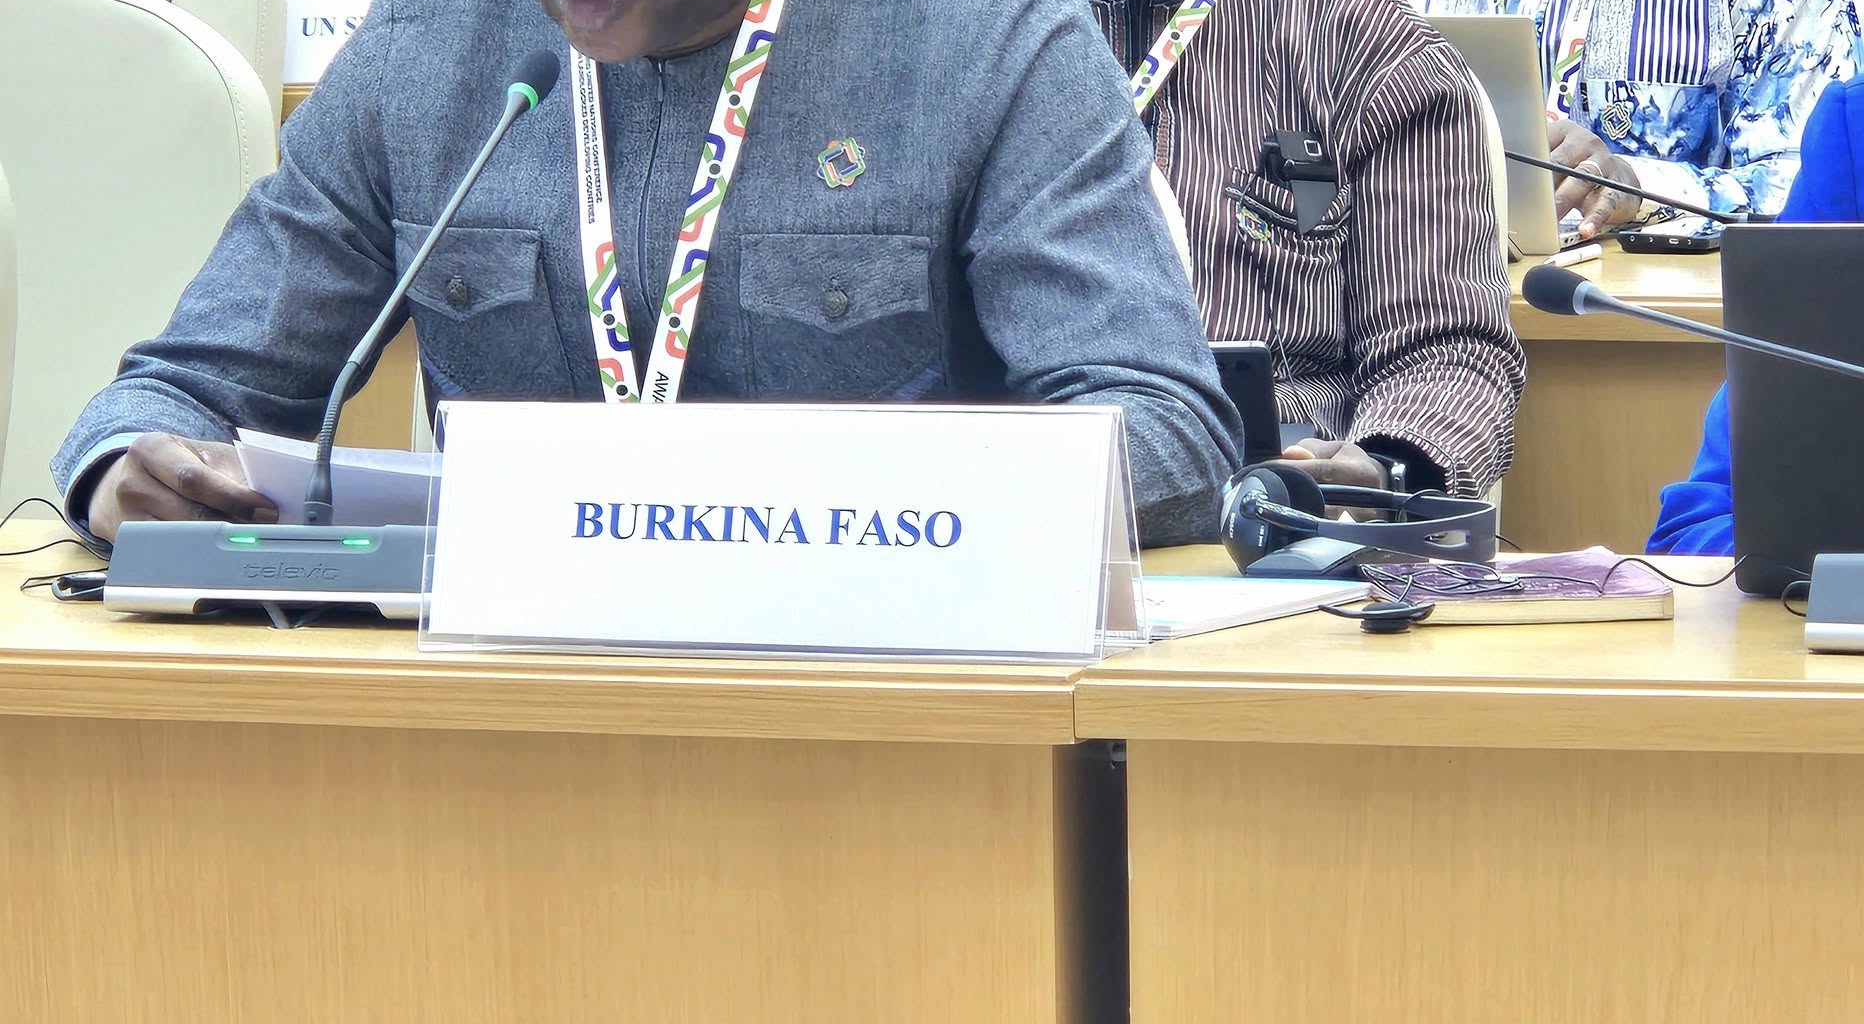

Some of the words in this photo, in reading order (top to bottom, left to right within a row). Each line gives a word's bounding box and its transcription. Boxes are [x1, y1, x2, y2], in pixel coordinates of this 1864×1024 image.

[302, 17, 336, 37] UN
[344, 16, 366, 36] S
[571, 502, 811, 545] BURKINA
[825, 507, 962, 548] FASO
[243, 561, 341, 580] televic
